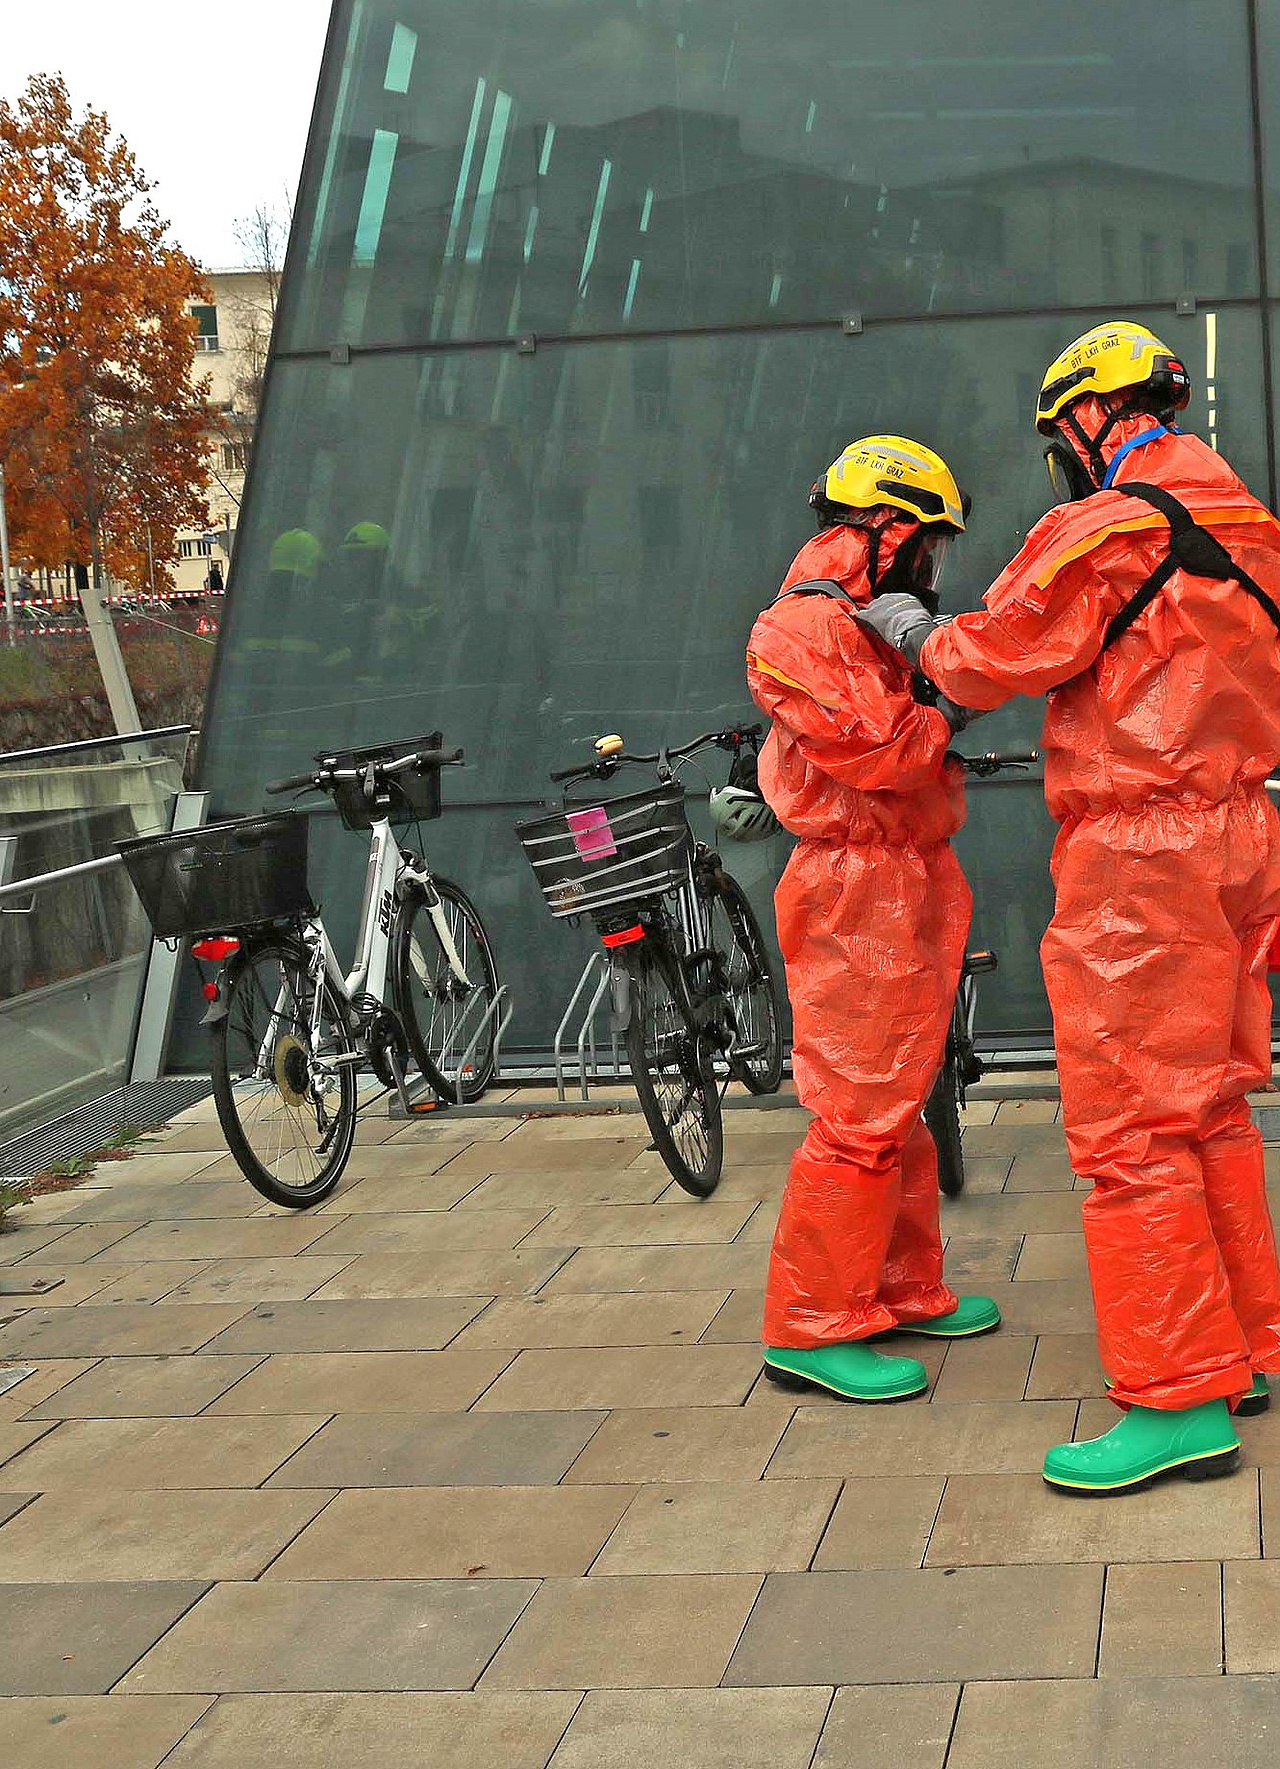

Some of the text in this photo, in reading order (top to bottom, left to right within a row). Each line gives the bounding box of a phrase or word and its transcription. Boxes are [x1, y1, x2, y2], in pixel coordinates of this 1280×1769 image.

[1085, 345, 1099, 359] LKH
[1101, 338, 1120, 350] GRAZ
[886, 464, 904, 480] GRAZ
[379, 888, 393, 938] KTM
